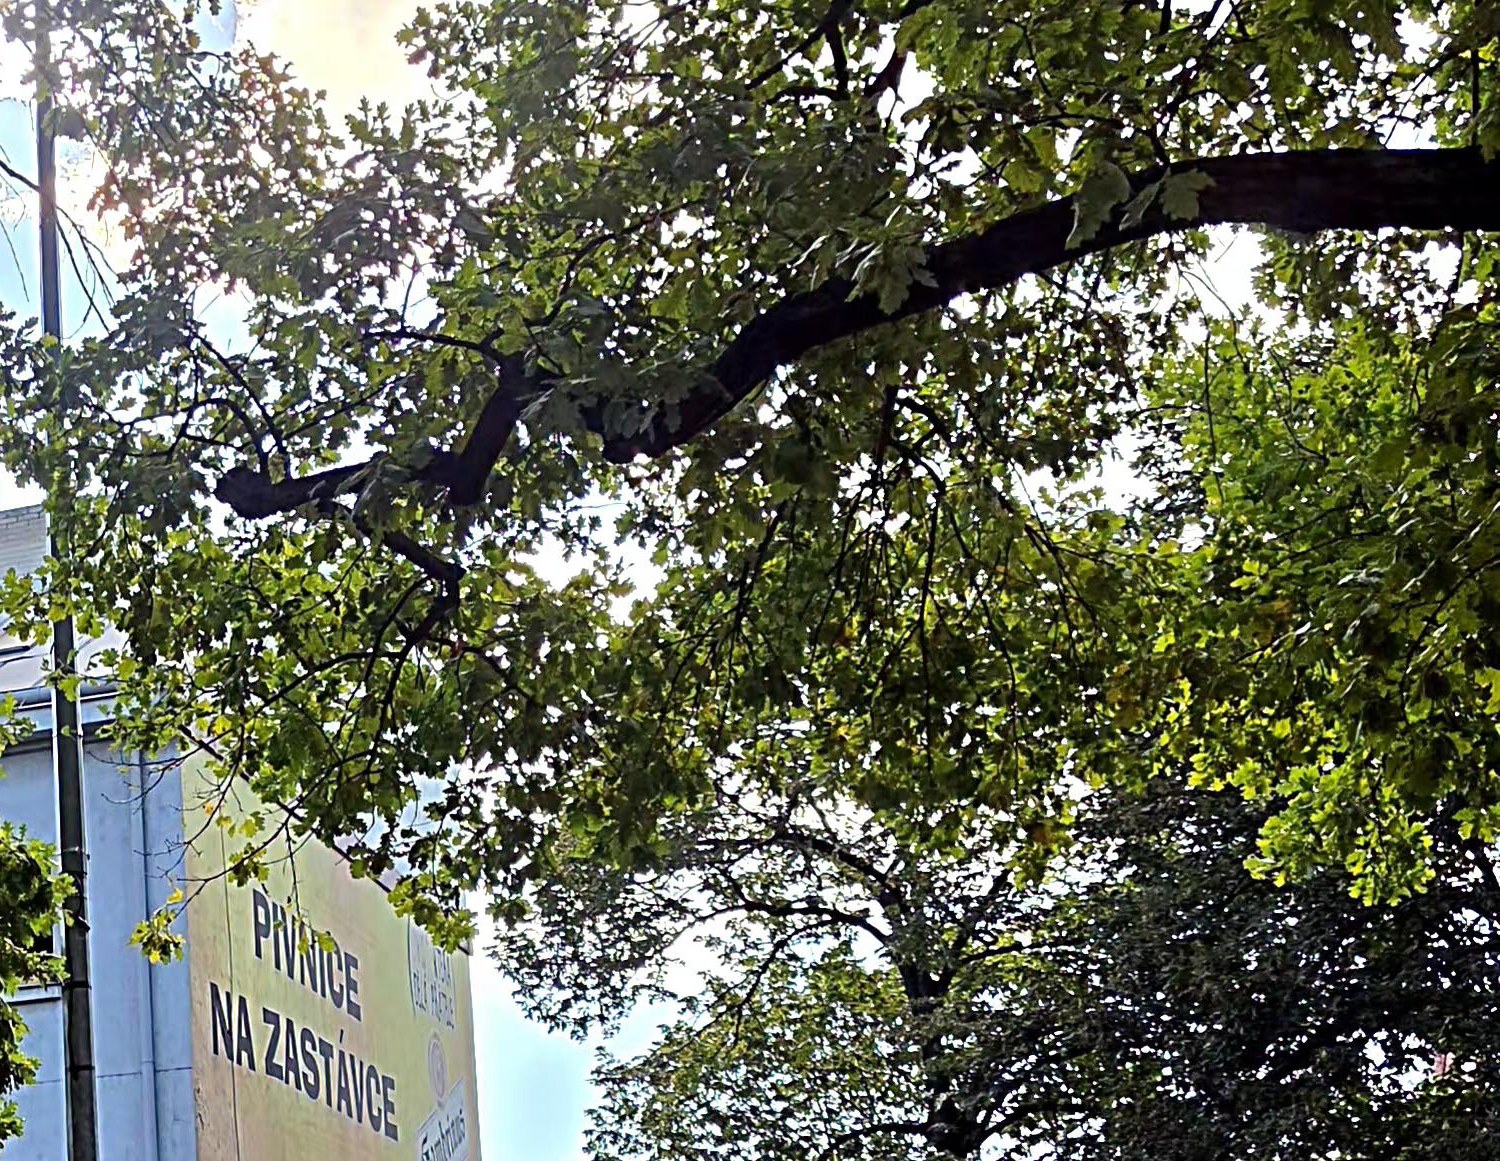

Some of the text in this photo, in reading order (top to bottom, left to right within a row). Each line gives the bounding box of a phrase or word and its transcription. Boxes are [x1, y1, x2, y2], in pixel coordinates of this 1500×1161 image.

[253, 888, 362, 1022] PIVNICE
[210, 982, 256, 1072] NA
[263, 1007, 399, 1142] ZASTÁVCE
